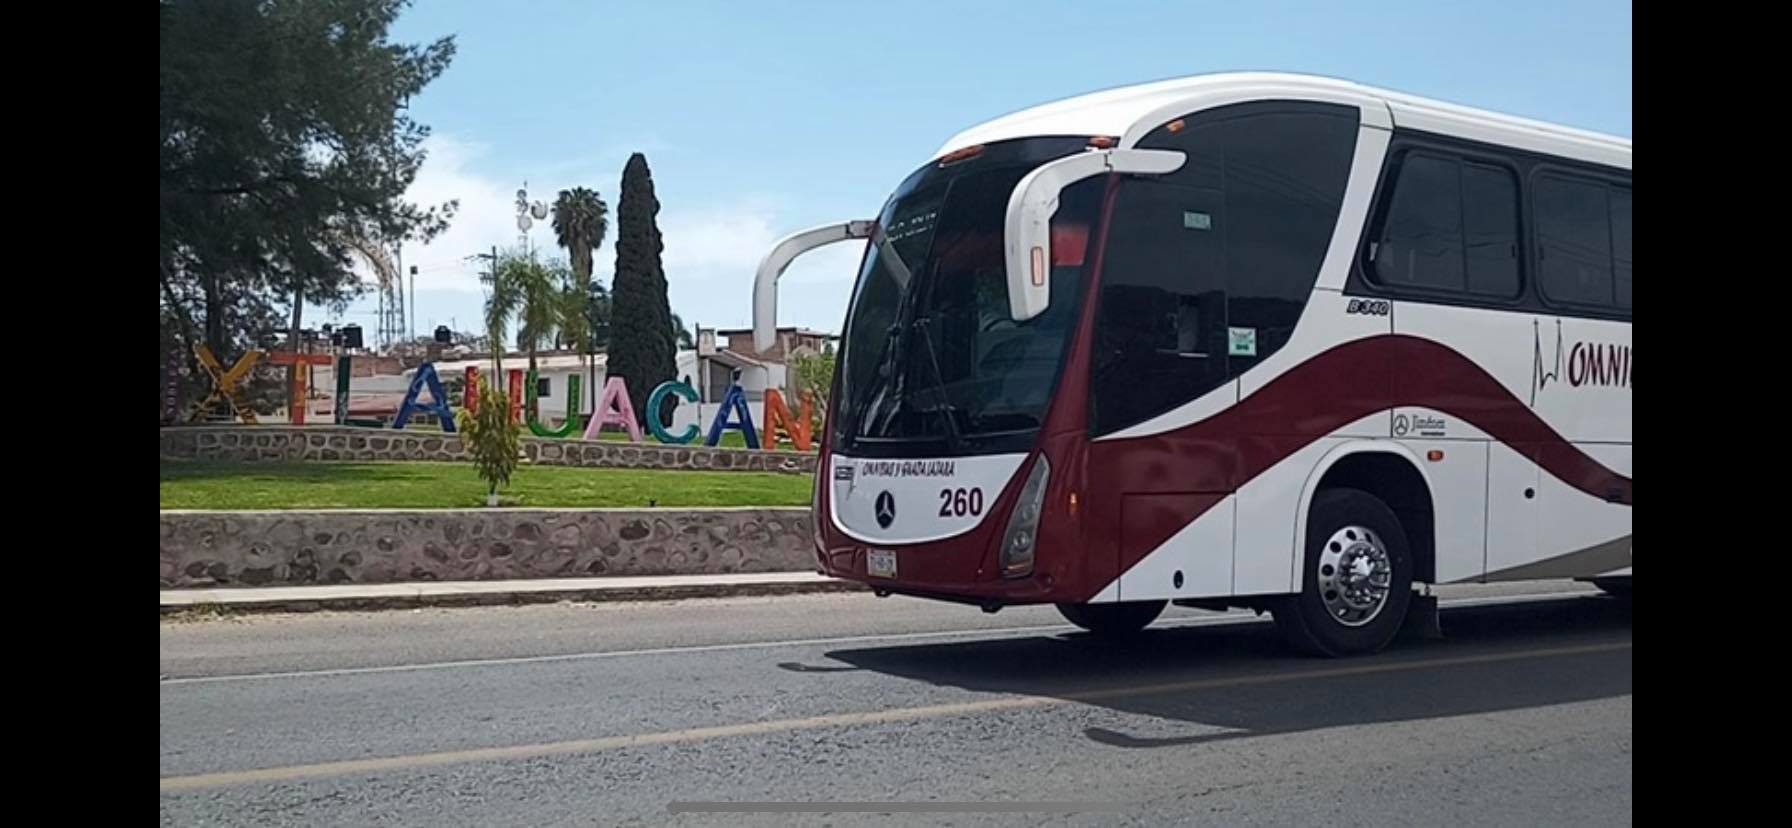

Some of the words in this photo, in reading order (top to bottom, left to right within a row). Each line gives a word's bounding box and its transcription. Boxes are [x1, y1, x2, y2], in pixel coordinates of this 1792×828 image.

[1347, 298, 1361, 314] B
[1361, 300, 1390, 316] 340
[1568, 341, 1632, 389] OMNI
[938, 487, 984, 518] 260
